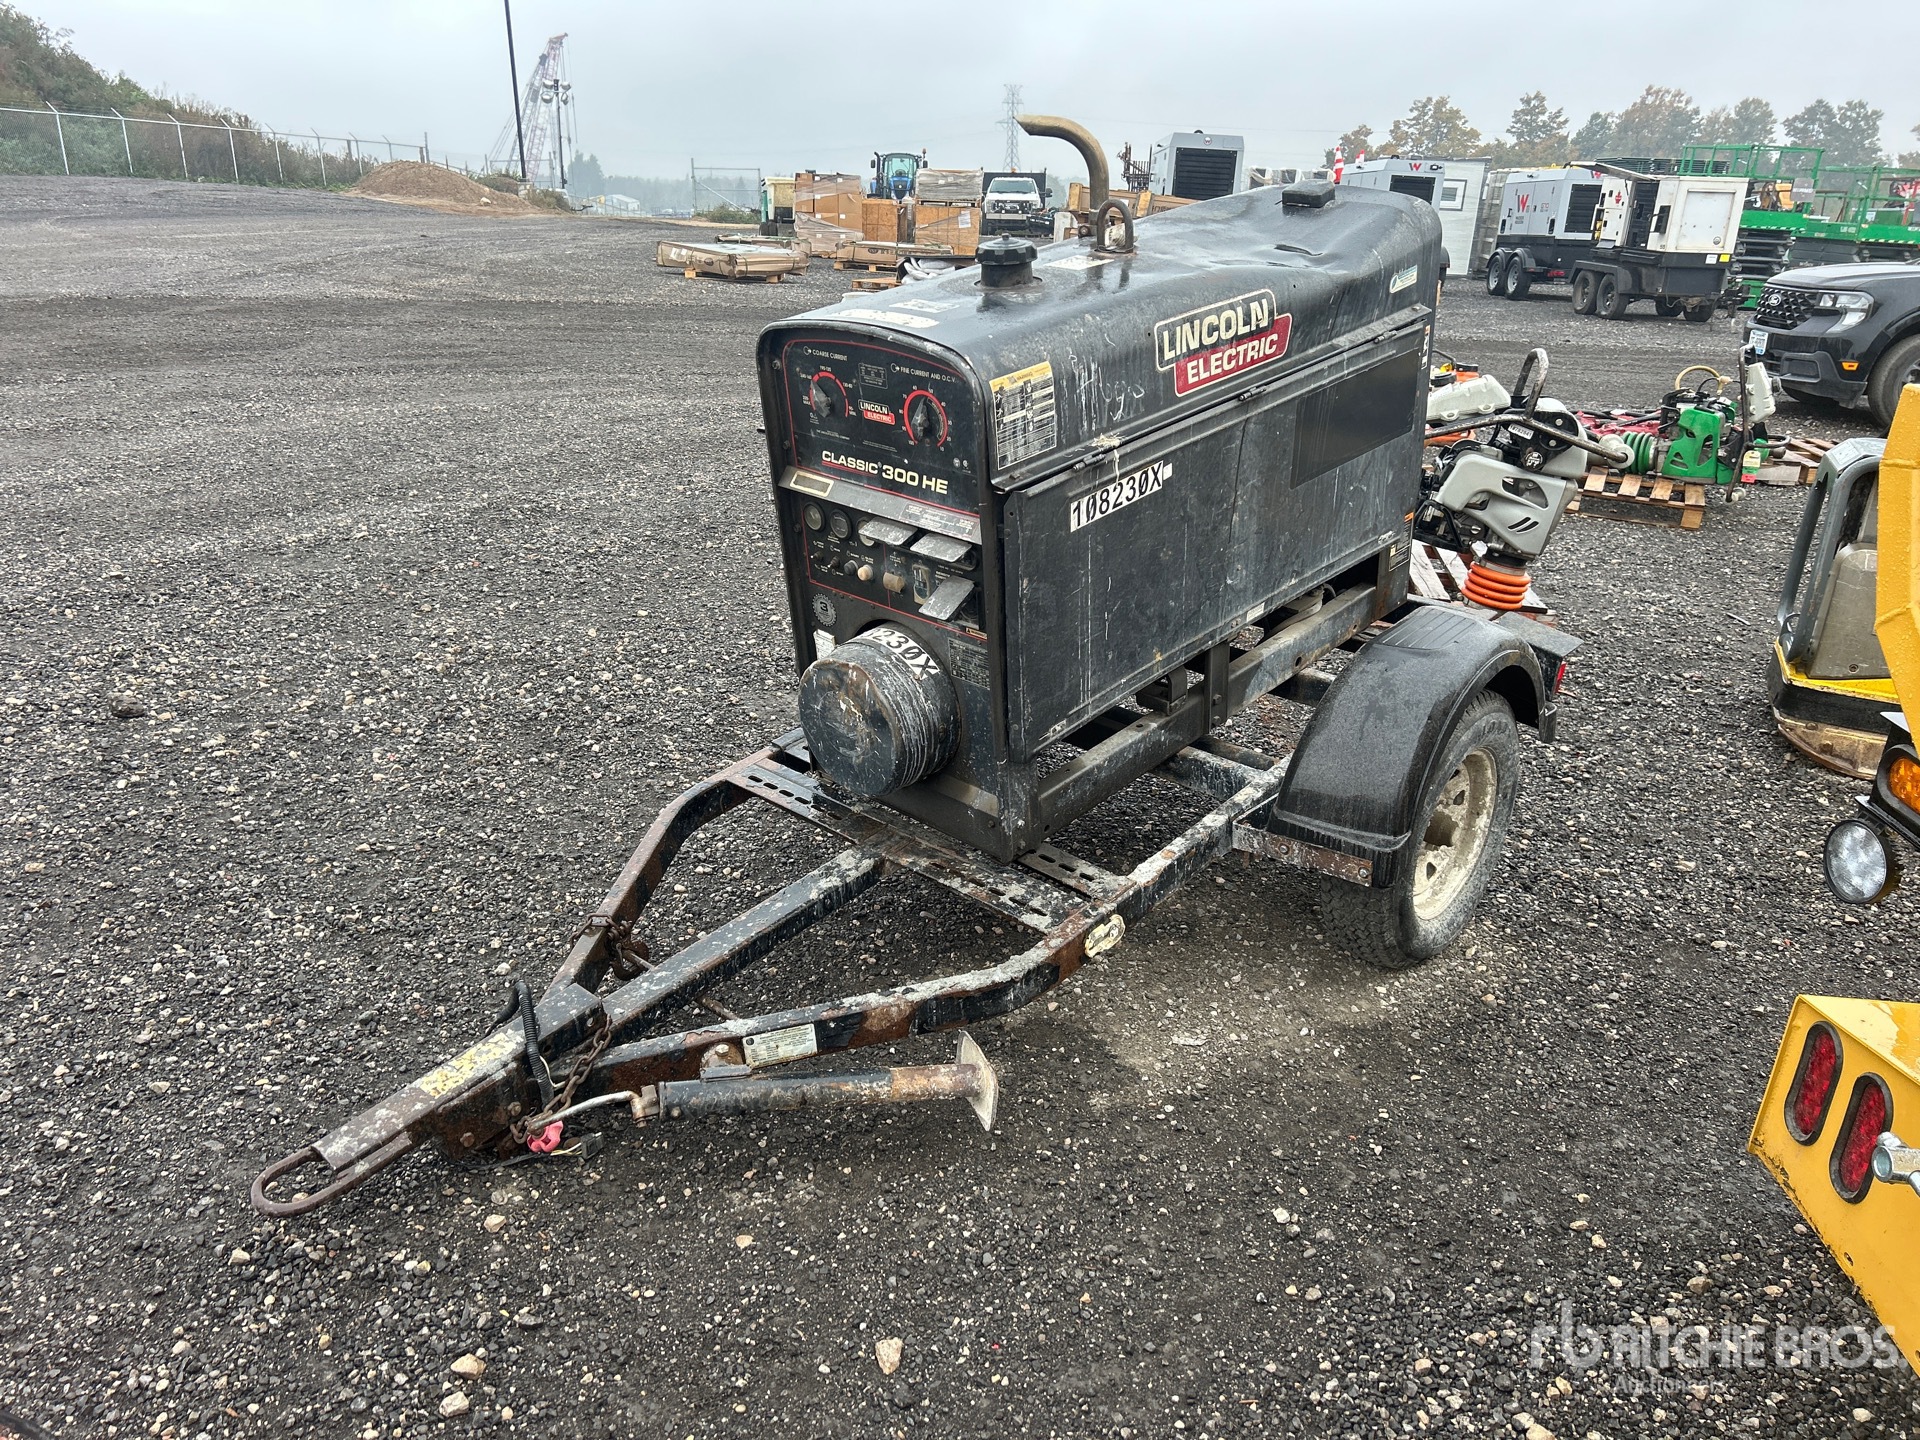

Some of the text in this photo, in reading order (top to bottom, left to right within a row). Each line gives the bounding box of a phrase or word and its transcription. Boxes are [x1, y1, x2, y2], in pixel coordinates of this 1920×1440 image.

[1162, 299, 1269, 361] LINCOLN
[812, 349, 848, 361] COARSE CURRENT
[1187, 334, 1279, 384] ELECTRIC
[900, 366, 910, 374] FINE
[910, 368, 930, 378] CURRENT
[930, 372, 941, 380] AND
[860, 401, 888, 415] LINCOLN
[867, 411, 892, 423] ELECTRIC
[882, 464, 919, 487] 300
[921, 474, 949, 495] HE
[1072, 461, 1162, 527] 108230X
[819, 601, 829, 612] 3
